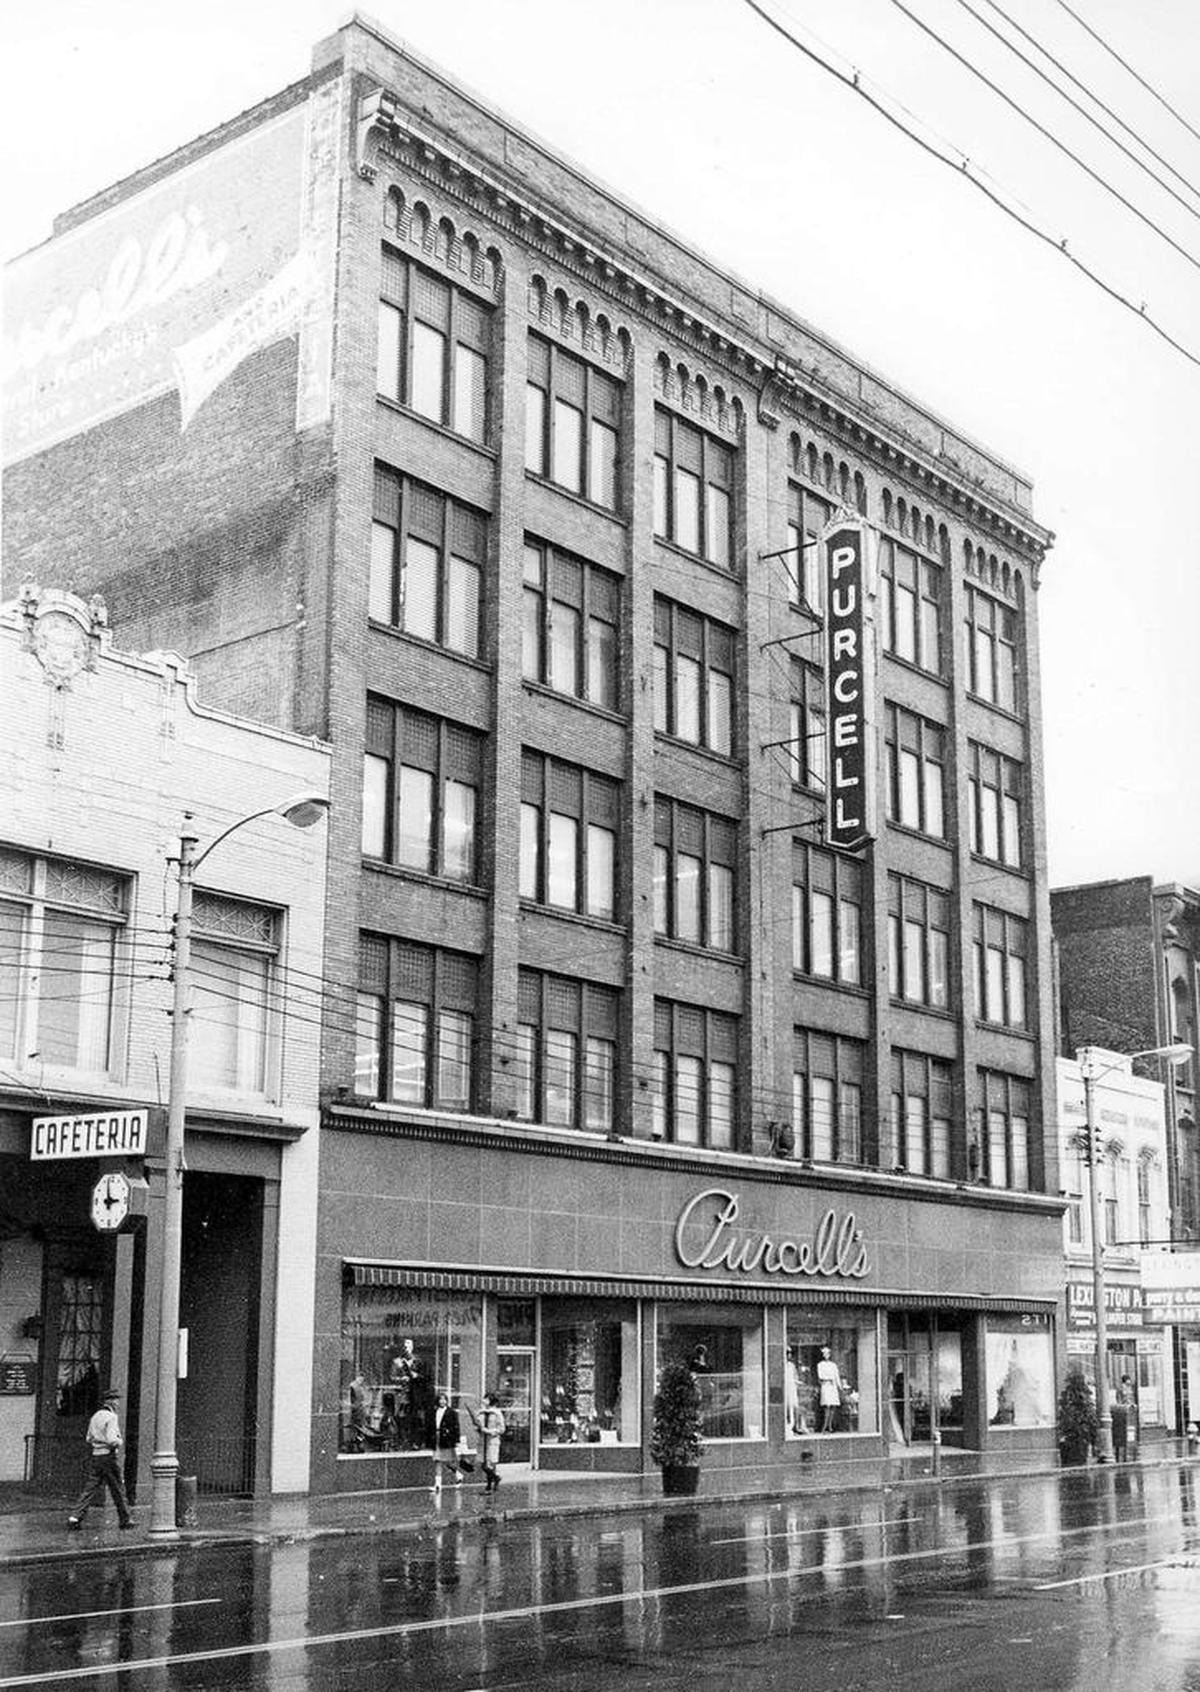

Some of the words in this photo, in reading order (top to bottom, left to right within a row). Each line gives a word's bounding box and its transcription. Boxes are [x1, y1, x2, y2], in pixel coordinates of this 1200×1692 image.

[832, 546, 859, 829] PURCELL
[35, 1116, 141, 1155] CAFETERIA
[675, 1189, 872, 1279] Purcell's
